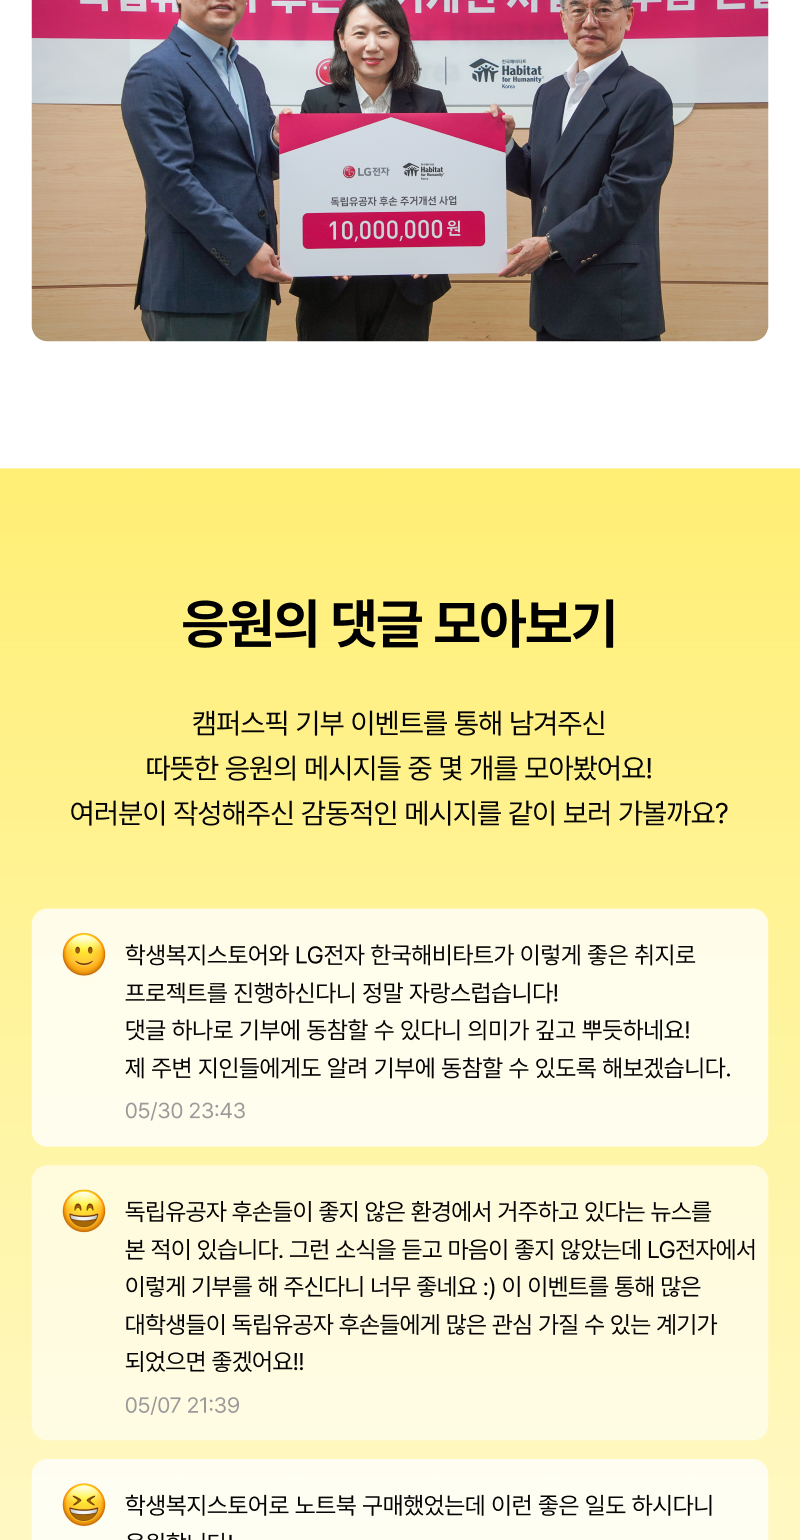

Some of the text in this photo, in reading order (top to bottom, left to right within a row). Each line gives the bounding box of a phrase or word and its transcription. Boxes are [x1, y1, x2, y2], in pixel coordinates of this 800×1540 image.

[502, 66, 542, 76] Habitat
[513, 76, 542, 84] Humanity
[357, 167, 390, 177] LG전자
[330, 195, 458, 207] 독립유공자 후손 주거개선 사업
[329, 219, 461, 242] 10,000,000 원
[183, 599, 613, 648] 응원의 댓글 모아보기
[147, 755, 651, 781] 따뜻한 응원의 메시지들 중 몇 개를 모아봤어요!
[125, 982, 557, 1004] 프로젝트를 진행하신다니 정말 자랑스럽습니다!
[126, 1102, 245, 1121] 05/30 23:43
[126, 1495, 712, 1516] 학생복지스토어로 노트북 구매했었는데 이런 좋은 일도 하시다니
